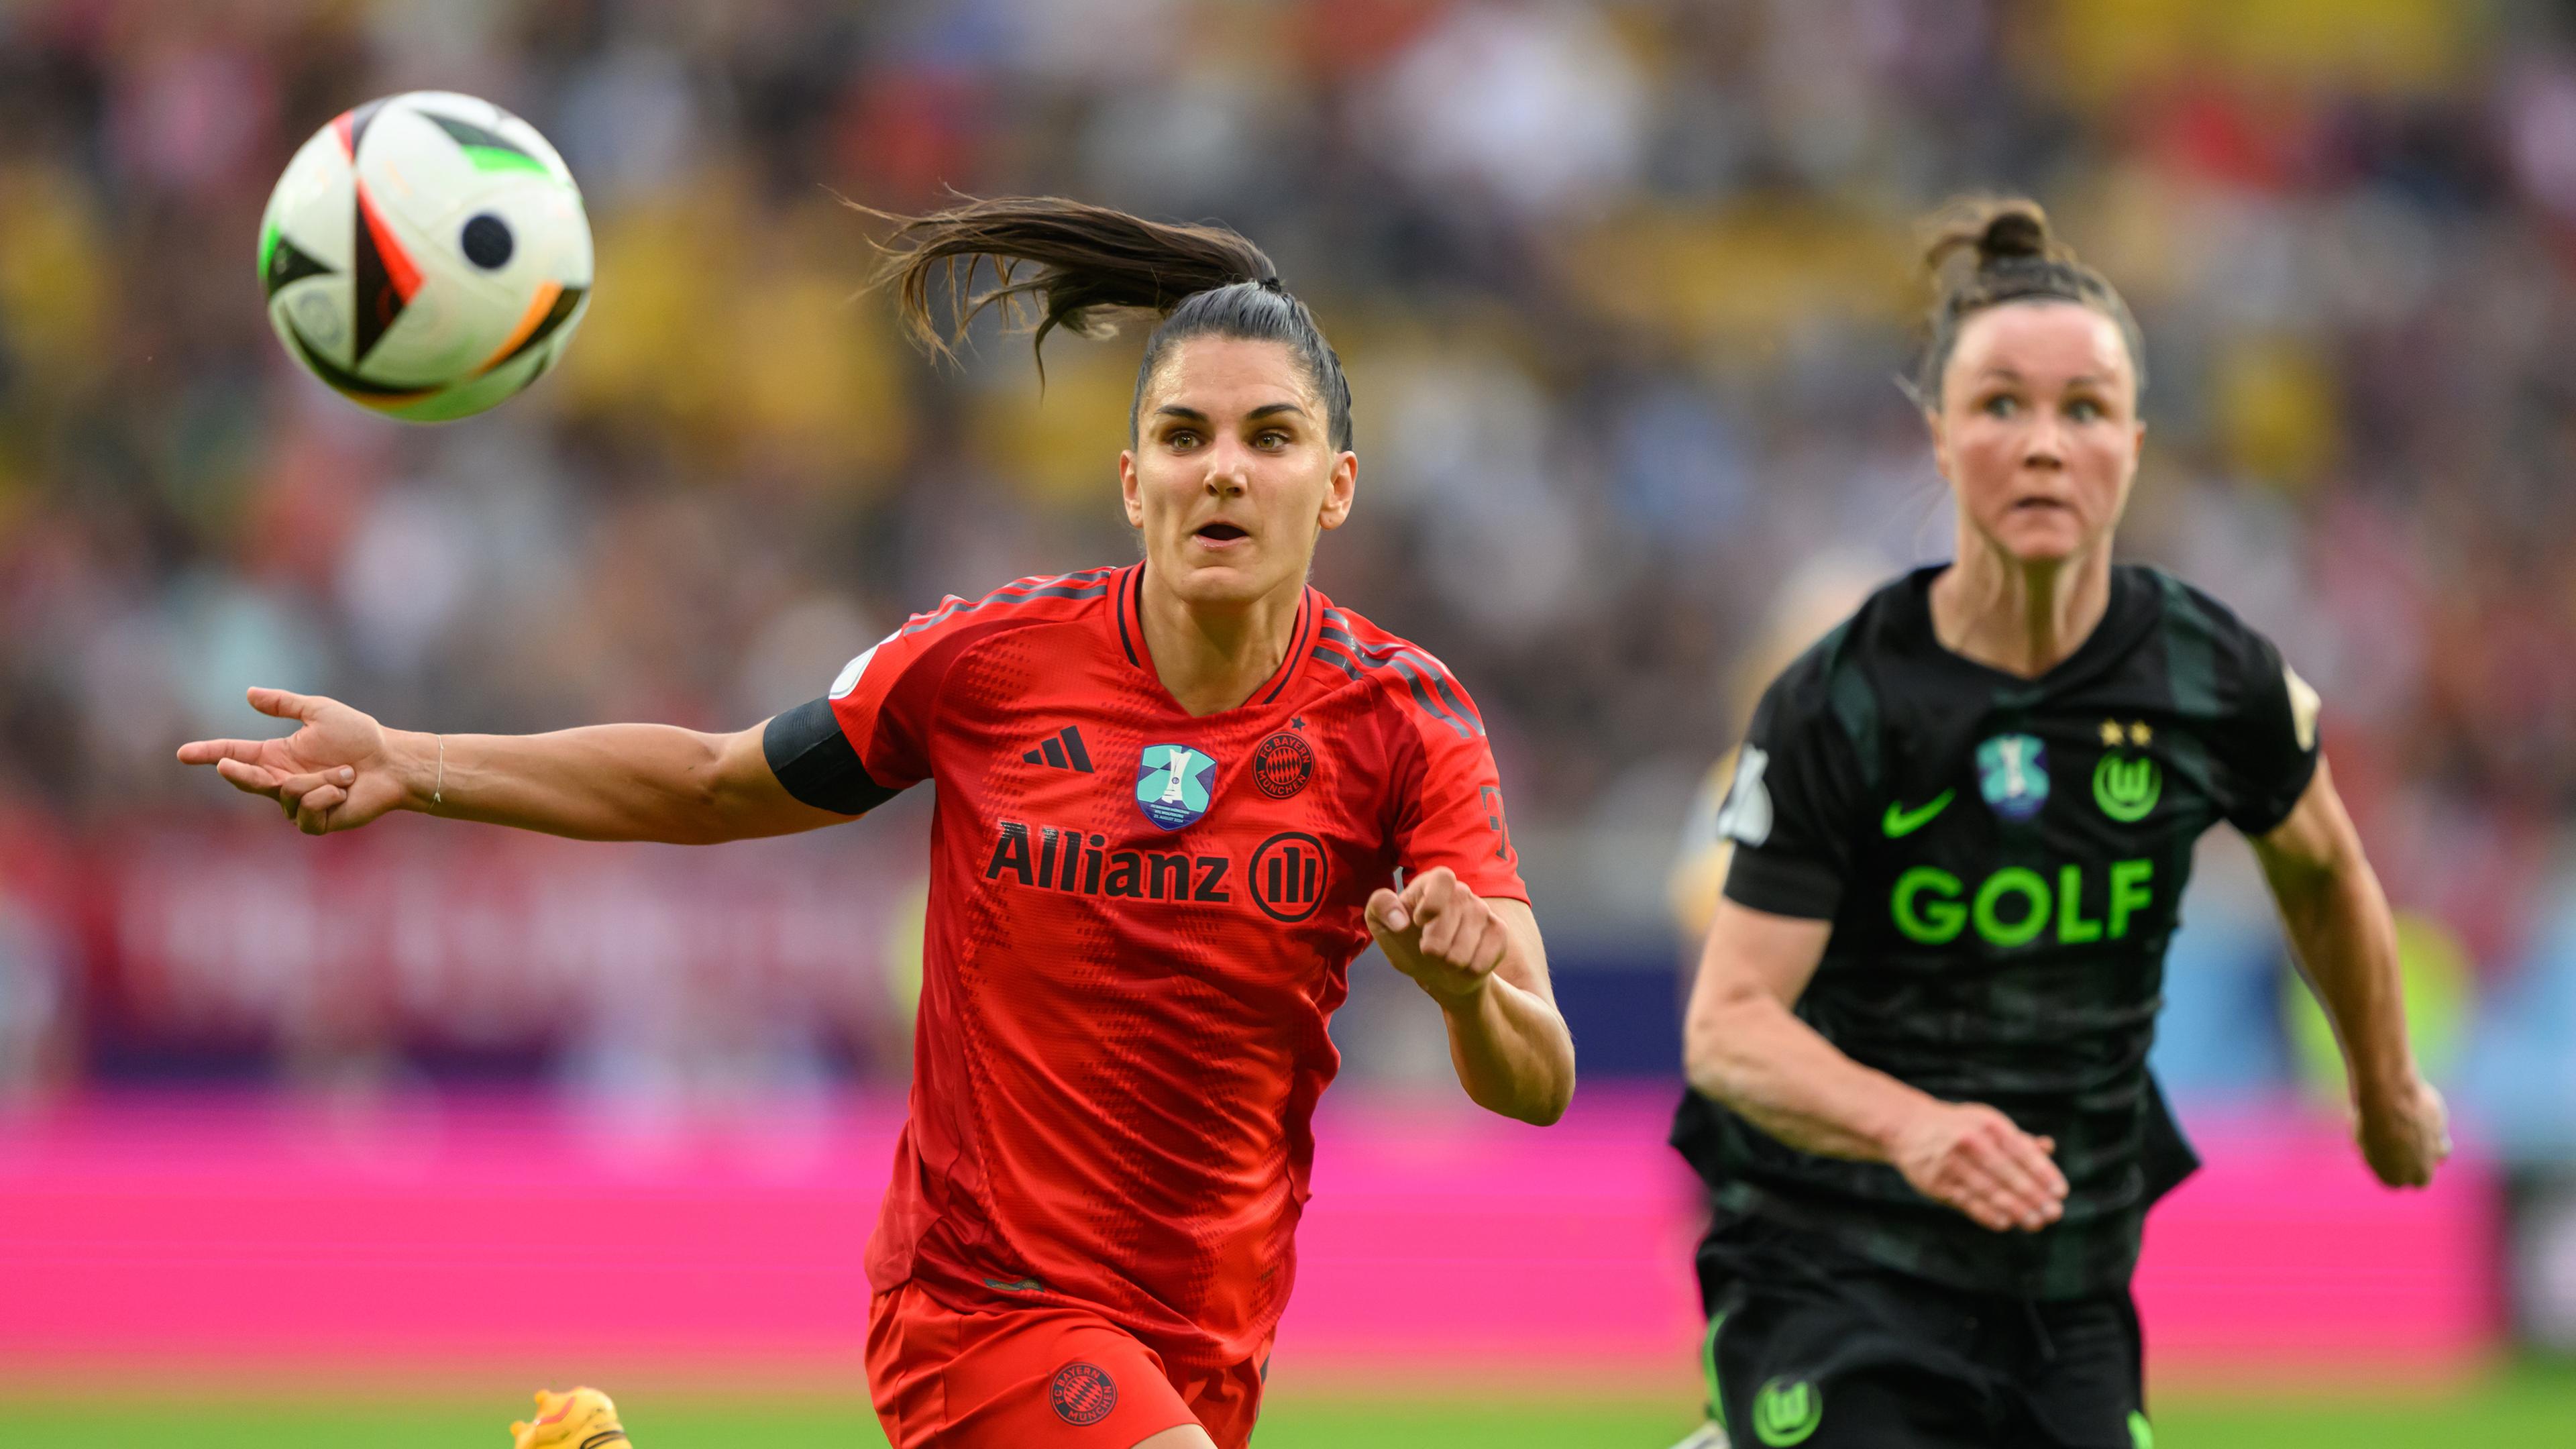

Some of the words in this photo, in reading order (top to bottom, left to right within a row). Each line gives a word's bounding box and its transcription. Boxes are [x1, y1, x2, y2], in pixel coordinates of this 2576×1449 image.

[1260, 744, 1272, 759] FC
[1273, 737, 1310, 763] BAYERN
[985, 820, 1229, 902] Allianz
[1890, 858, 2153, 947] GOLF
[1057, 1366, 1100, 1387] BAYERN
[1054, 1389, 1065, 1405] FC
